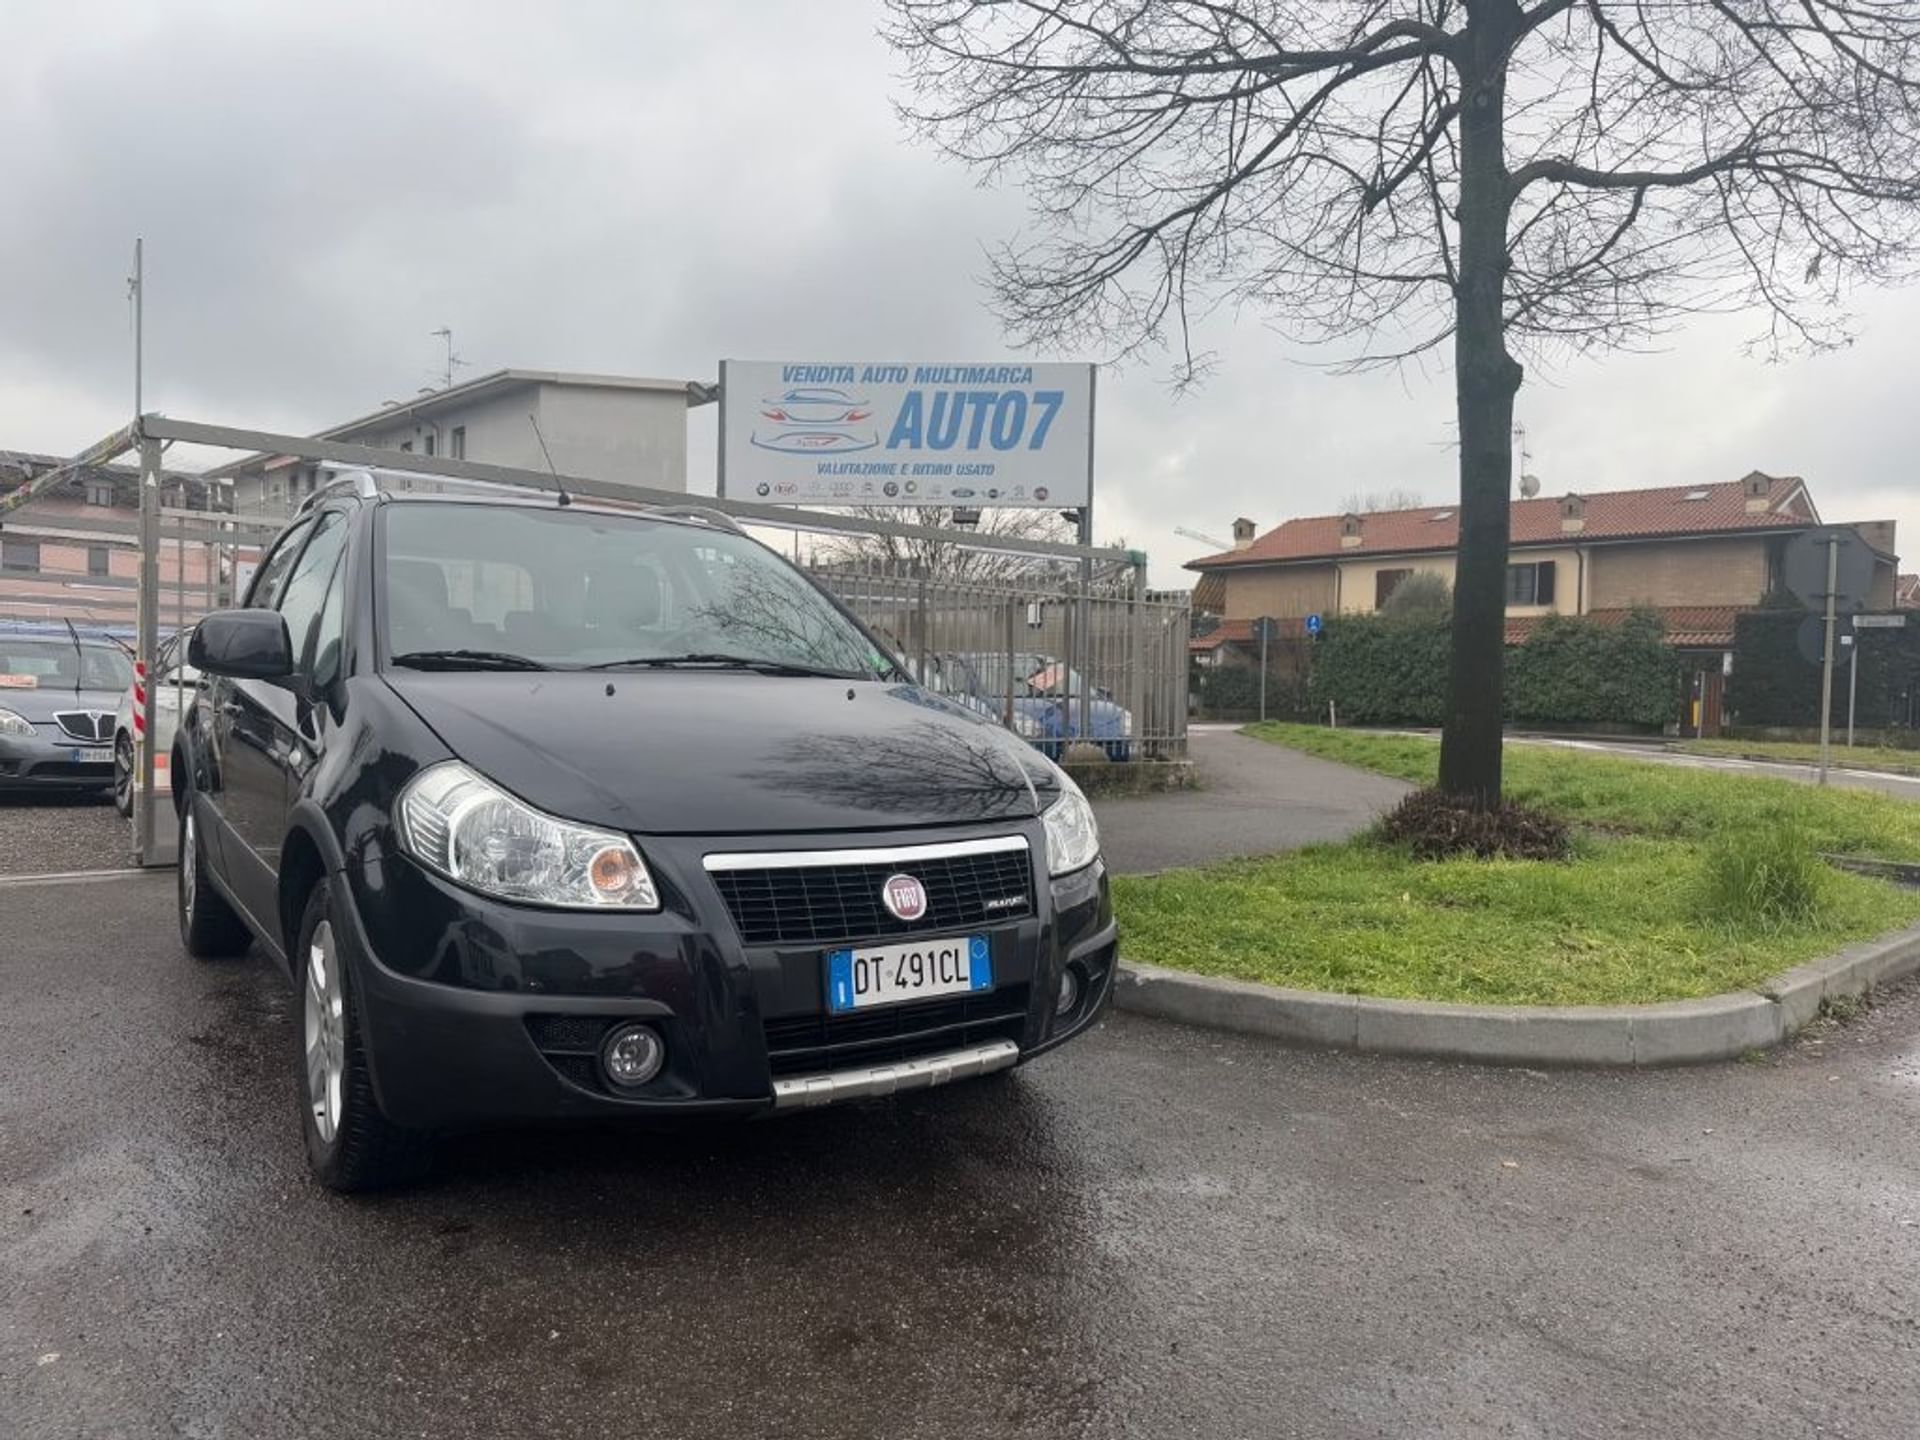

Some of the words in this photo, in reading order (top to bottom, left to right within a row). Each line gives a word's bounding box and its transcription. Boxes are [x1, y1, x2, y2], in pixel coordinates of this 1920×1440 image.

[782, 365, 854, 383] VENDITA
[860, 365, 909, 384] AUTO
[914, 366, 1033, 384] MULTIMARCA
[885, 390, 1065, 451] AUTO7
[817, 463, 897, 476] VALUTAZIONE
[901, 463, 910, 476] E
[912, 463, 952, 476] RITIRO
[956, 464, 996, 476] USATO
[893, 887, 918, 909] FIAT
[855, 956, 885, 995] DT
[895, 948, 969, 989] 491CL
